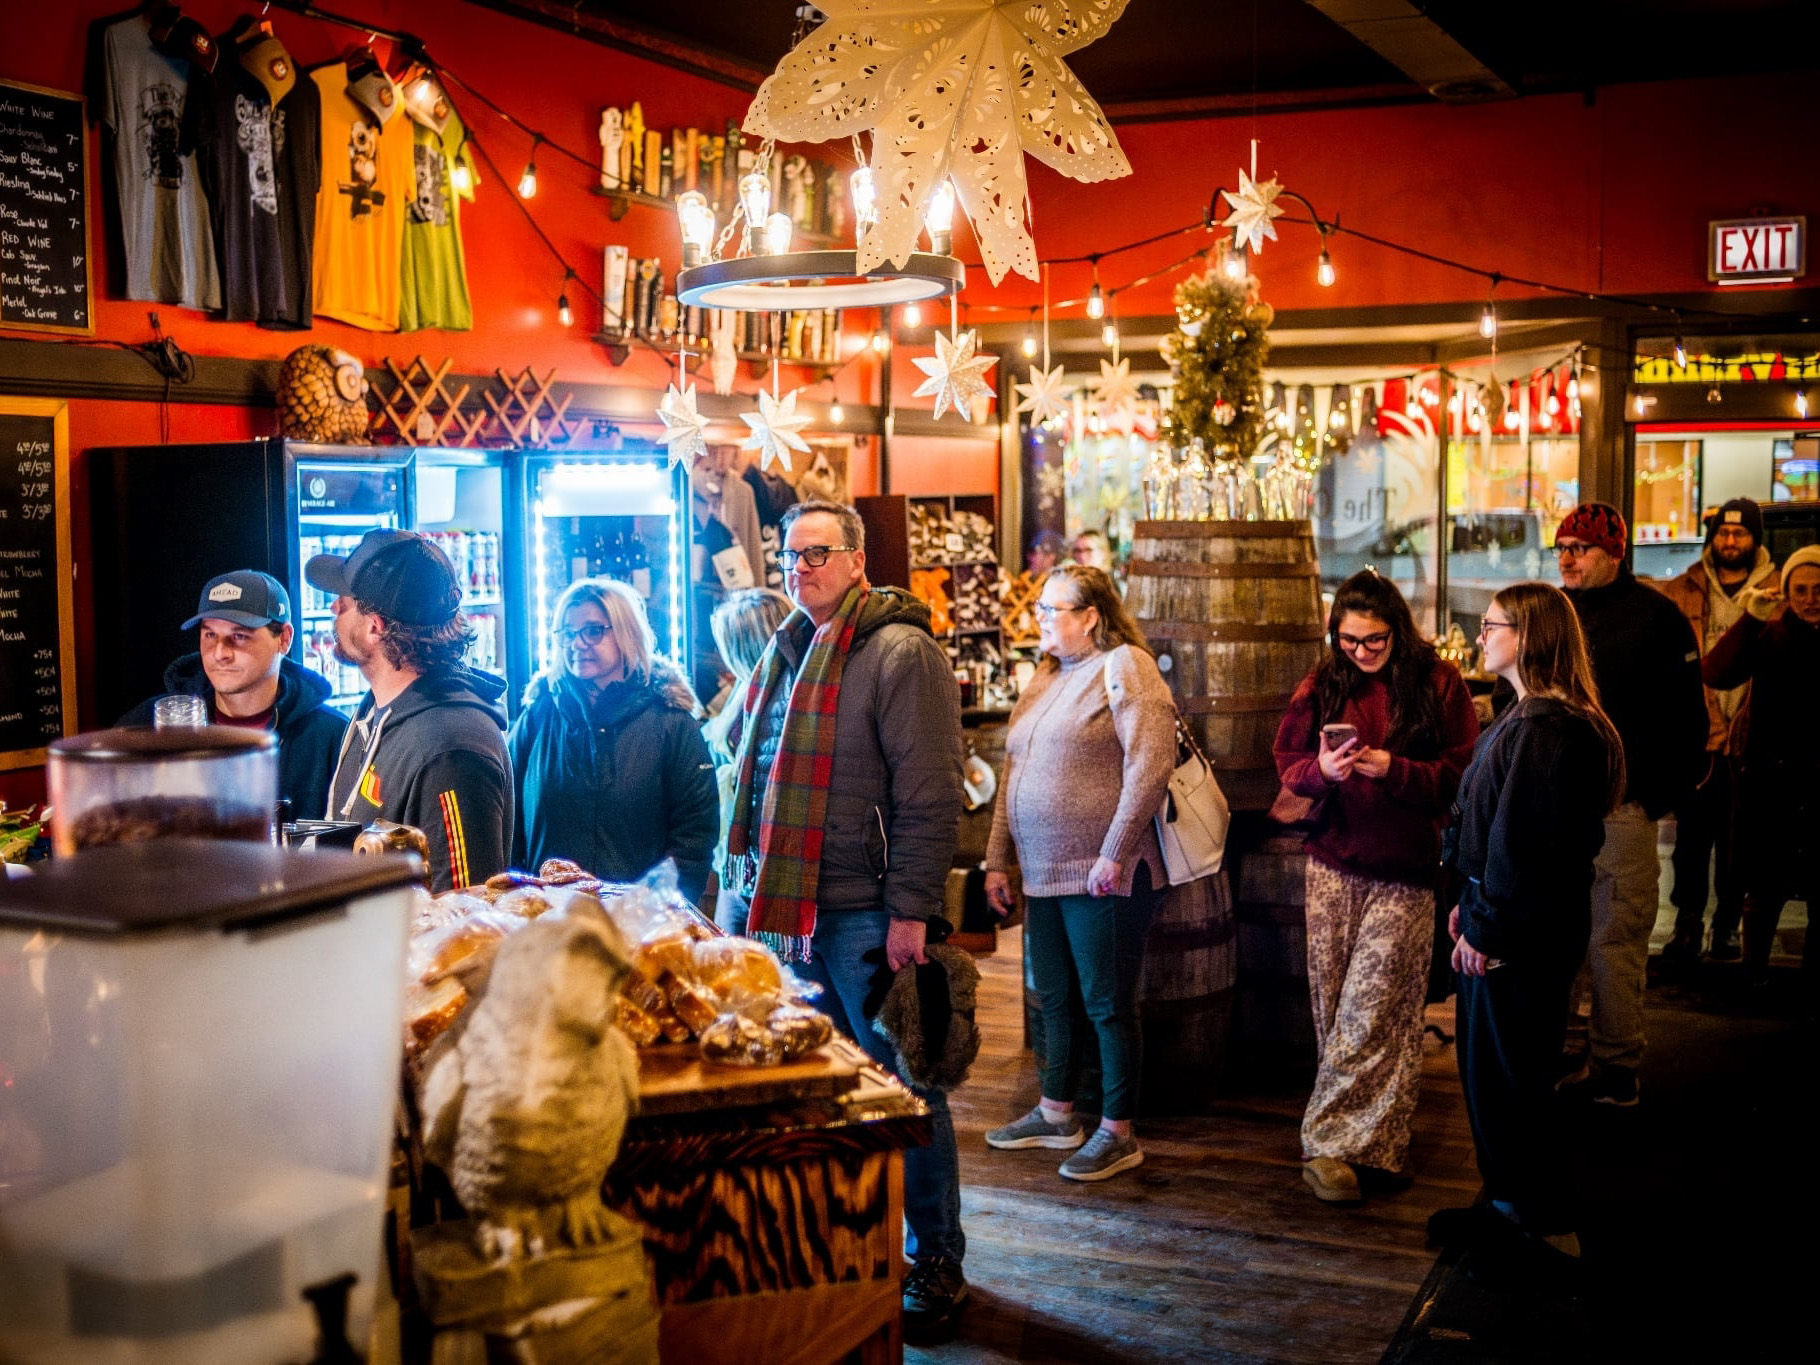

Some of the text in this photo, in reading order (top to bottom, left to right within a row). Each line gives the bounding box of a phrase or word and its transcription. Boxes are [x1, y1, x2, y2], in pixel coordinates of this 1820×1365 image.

[31, 105, 55, 120] WINE
[1, 230, 52, 249] RED WINE
[1721, 226, 1793, 271] EXIT
